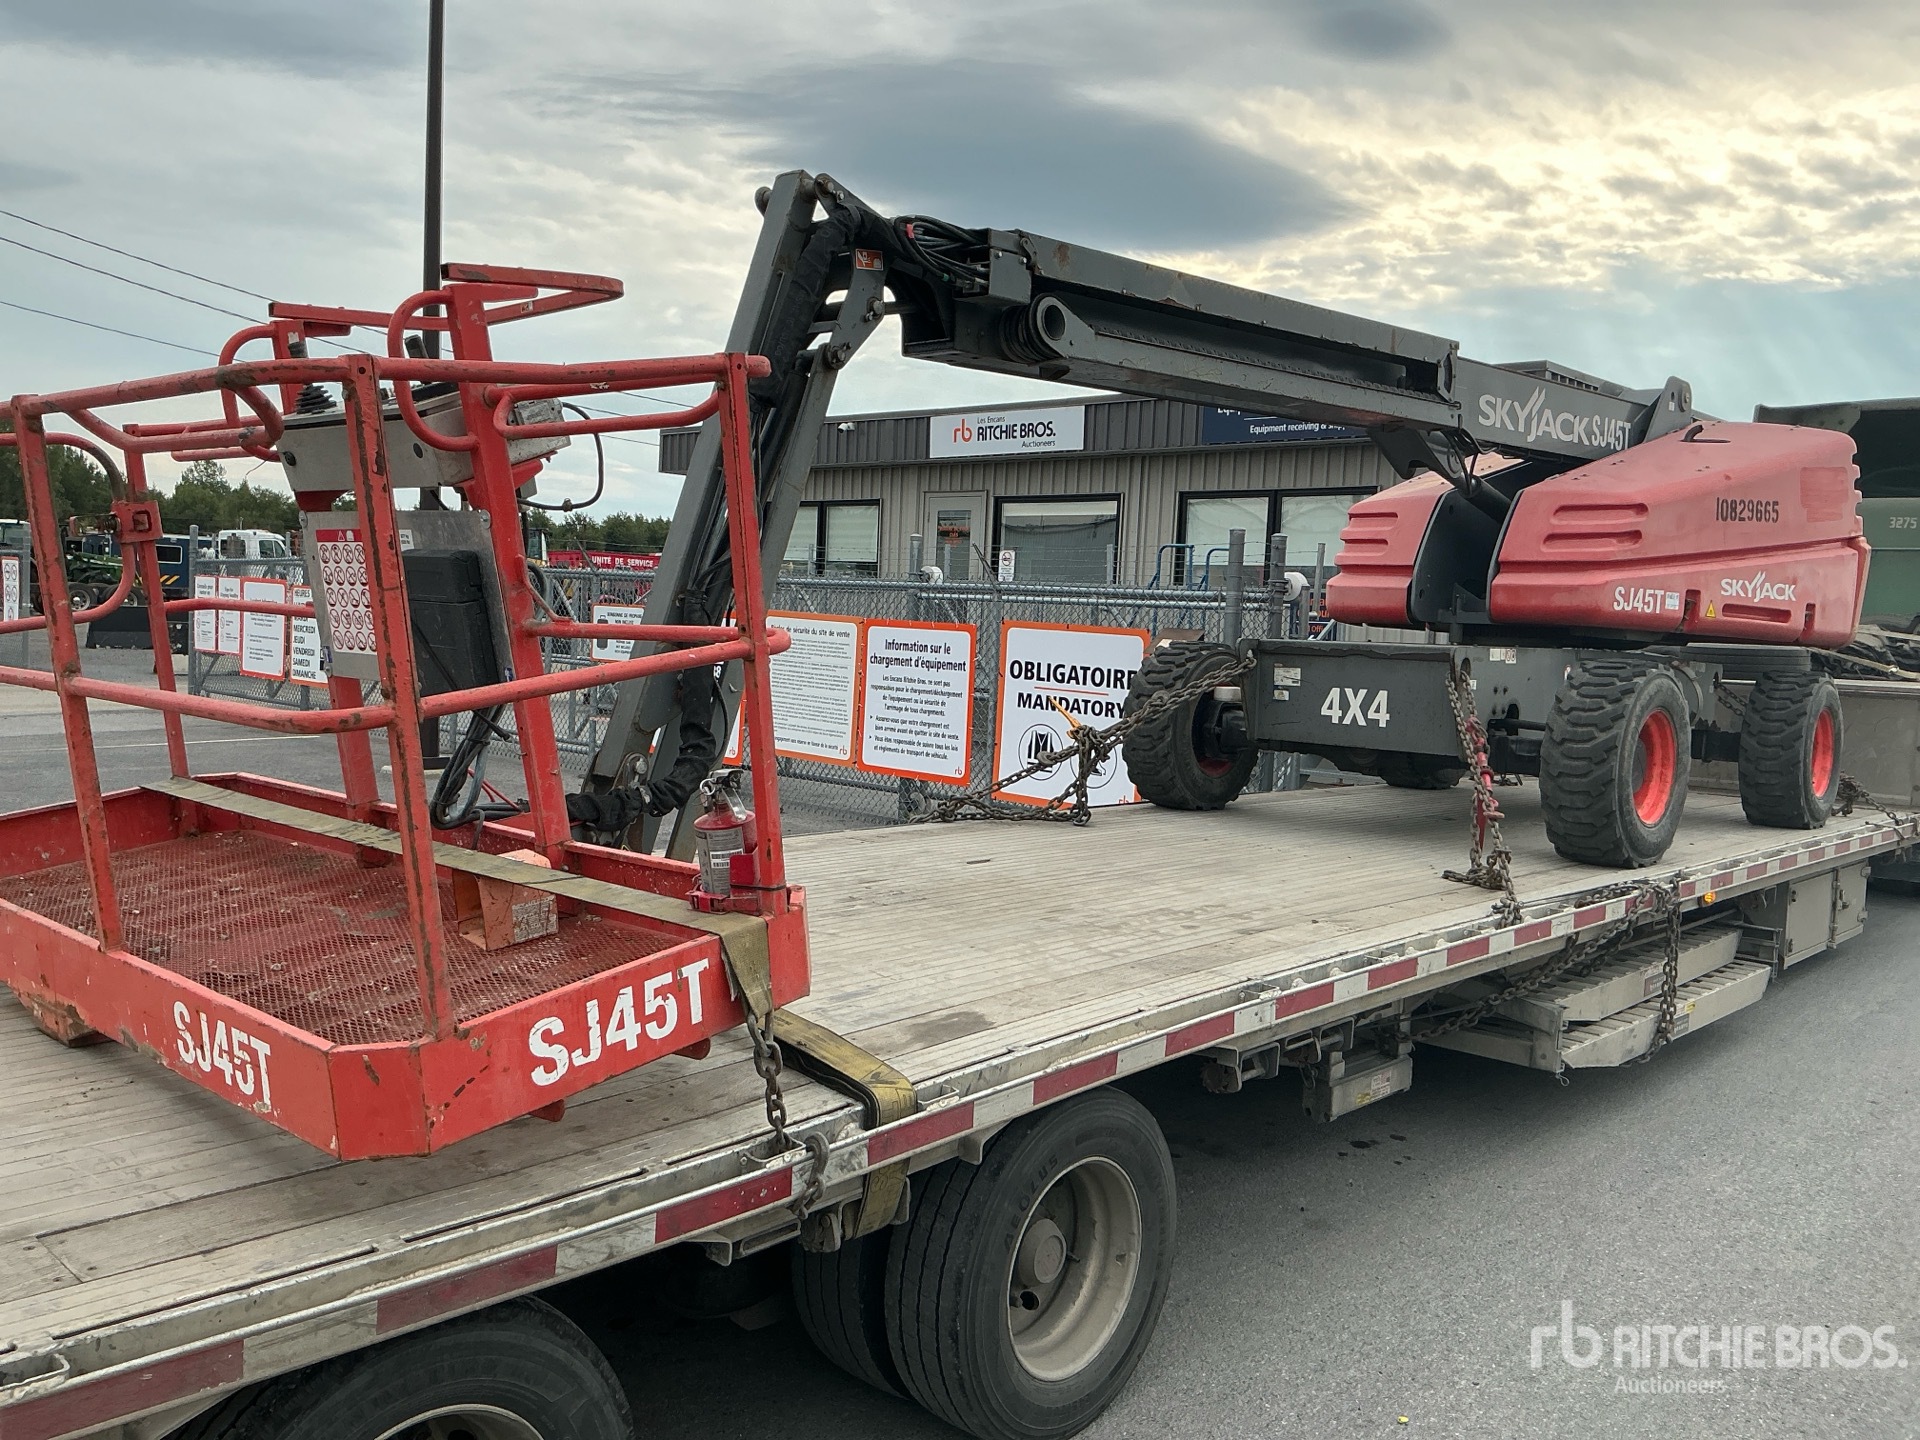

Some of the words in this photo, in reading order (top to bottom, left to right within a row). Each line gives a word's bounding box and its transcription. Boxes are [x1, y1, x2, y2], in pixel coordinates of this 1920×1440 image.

[987, 416, 1005, 424] Encans
[1478, 386, 1590, 446] SKYJACK
[1592, 414, 1632, 451] SJ45T
[977, 424, 1018, 442] RITCHIE
[1020, 421, 1056, 439] BROS.
[1250, 424, 1286, 434] Equipment
[1288, 422, 1320, 432] receiving
[1022, 440, 1056, 448] Auctioneers
[1716, 497, 1779, 523] 10829665
[1889, 516, 1917, 529] 3275
[628, 558, 654, 568] SERVICE
[1613, 586, 1664, 614] SJ45T
[1720, 571, 1796, 602] SKYJACK
[294, 624, 316, 634] MERCREDI
[793, 624, 810, 635] sécurité
[811, 626, 818, 636] du
[819, 628, 828, 636] site
[828, 628, 835, 637] de
[836, 630, 850, 639] vente
[293, 636, 306, 644] JEUDI
[885, 639, 928, 653] Information
[930, 644, 942, 654] sur
[944, 642, 951, 654] le
[293, 646, 316, 656] VENDREDI
[292, 658, 310, 668] SAMEDI
[870, 652, 912, 668] chargement
[914, 656, 966, 672] d'équipement
[292, 668, 316, 680] DIMANCHE
[1320, 687, 1390, 728] 4X4
[954, 766, 962, 776] rb
[529, 958, 710, 1086] SJ45T
[174, 1001, 272, 1112] SJ45T
